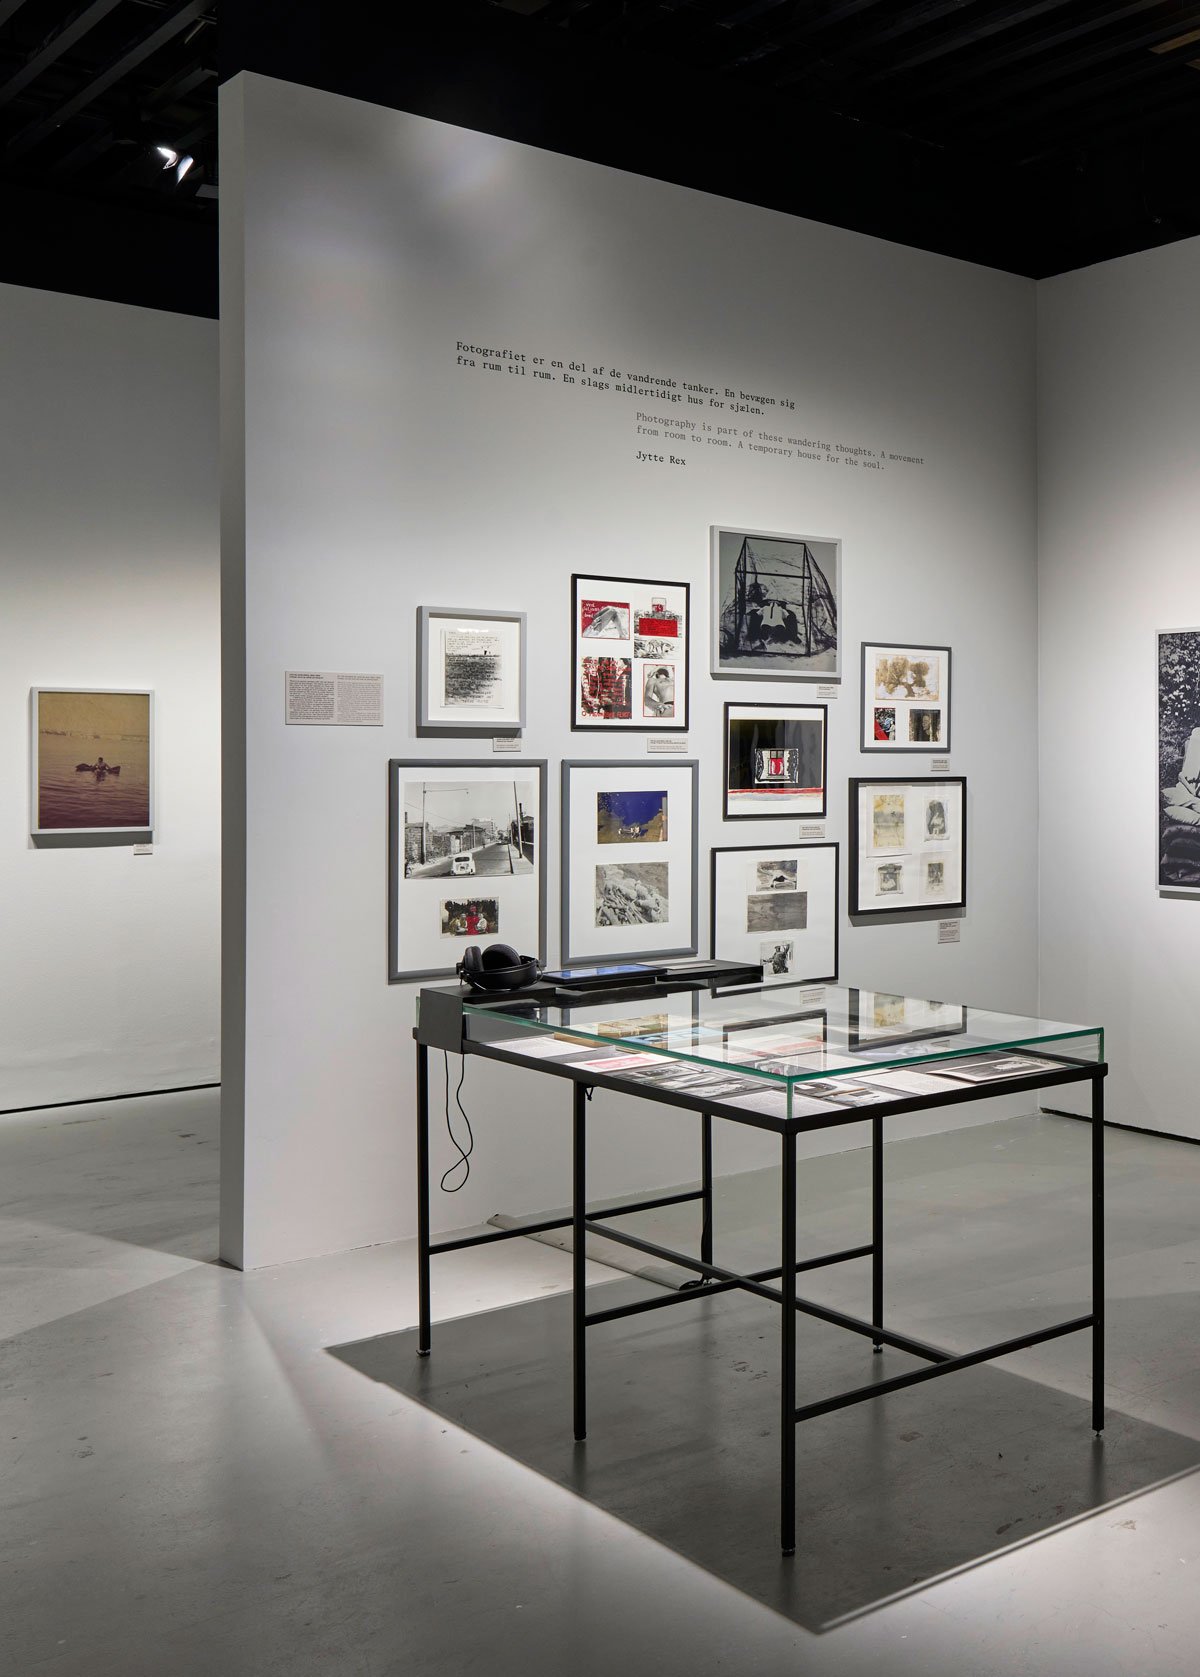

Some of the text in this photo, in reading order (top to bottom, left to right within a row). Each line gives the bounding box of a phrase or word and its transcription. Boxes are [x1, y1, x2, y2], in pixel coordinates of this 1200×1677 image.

[456, 341, 526, 362] Fotografiet
[532, 357, 545, 365] er
[550, 360, 563, 369] en
[568, 361, 586, 373] del
[592, 366, 605, 375] af
[609, 368, 622, 379] de
[627, 373, 677, 388] vandrende
[682, 382, 719, 395] tanker.
[724, 388, 735, 398] En
[780, 398, 795, 410] sig
[456, 355, 765, 415] fra rum til rum. En slags midlertidigt hus for sjælen.
[636, 411, 925, 465] Photography is part of these wandering thoughts. A movement
[636, 425, 885, 470] from room to room. A temporary house for the soul.
[636, 450, 687, 466] Jytte Rex
